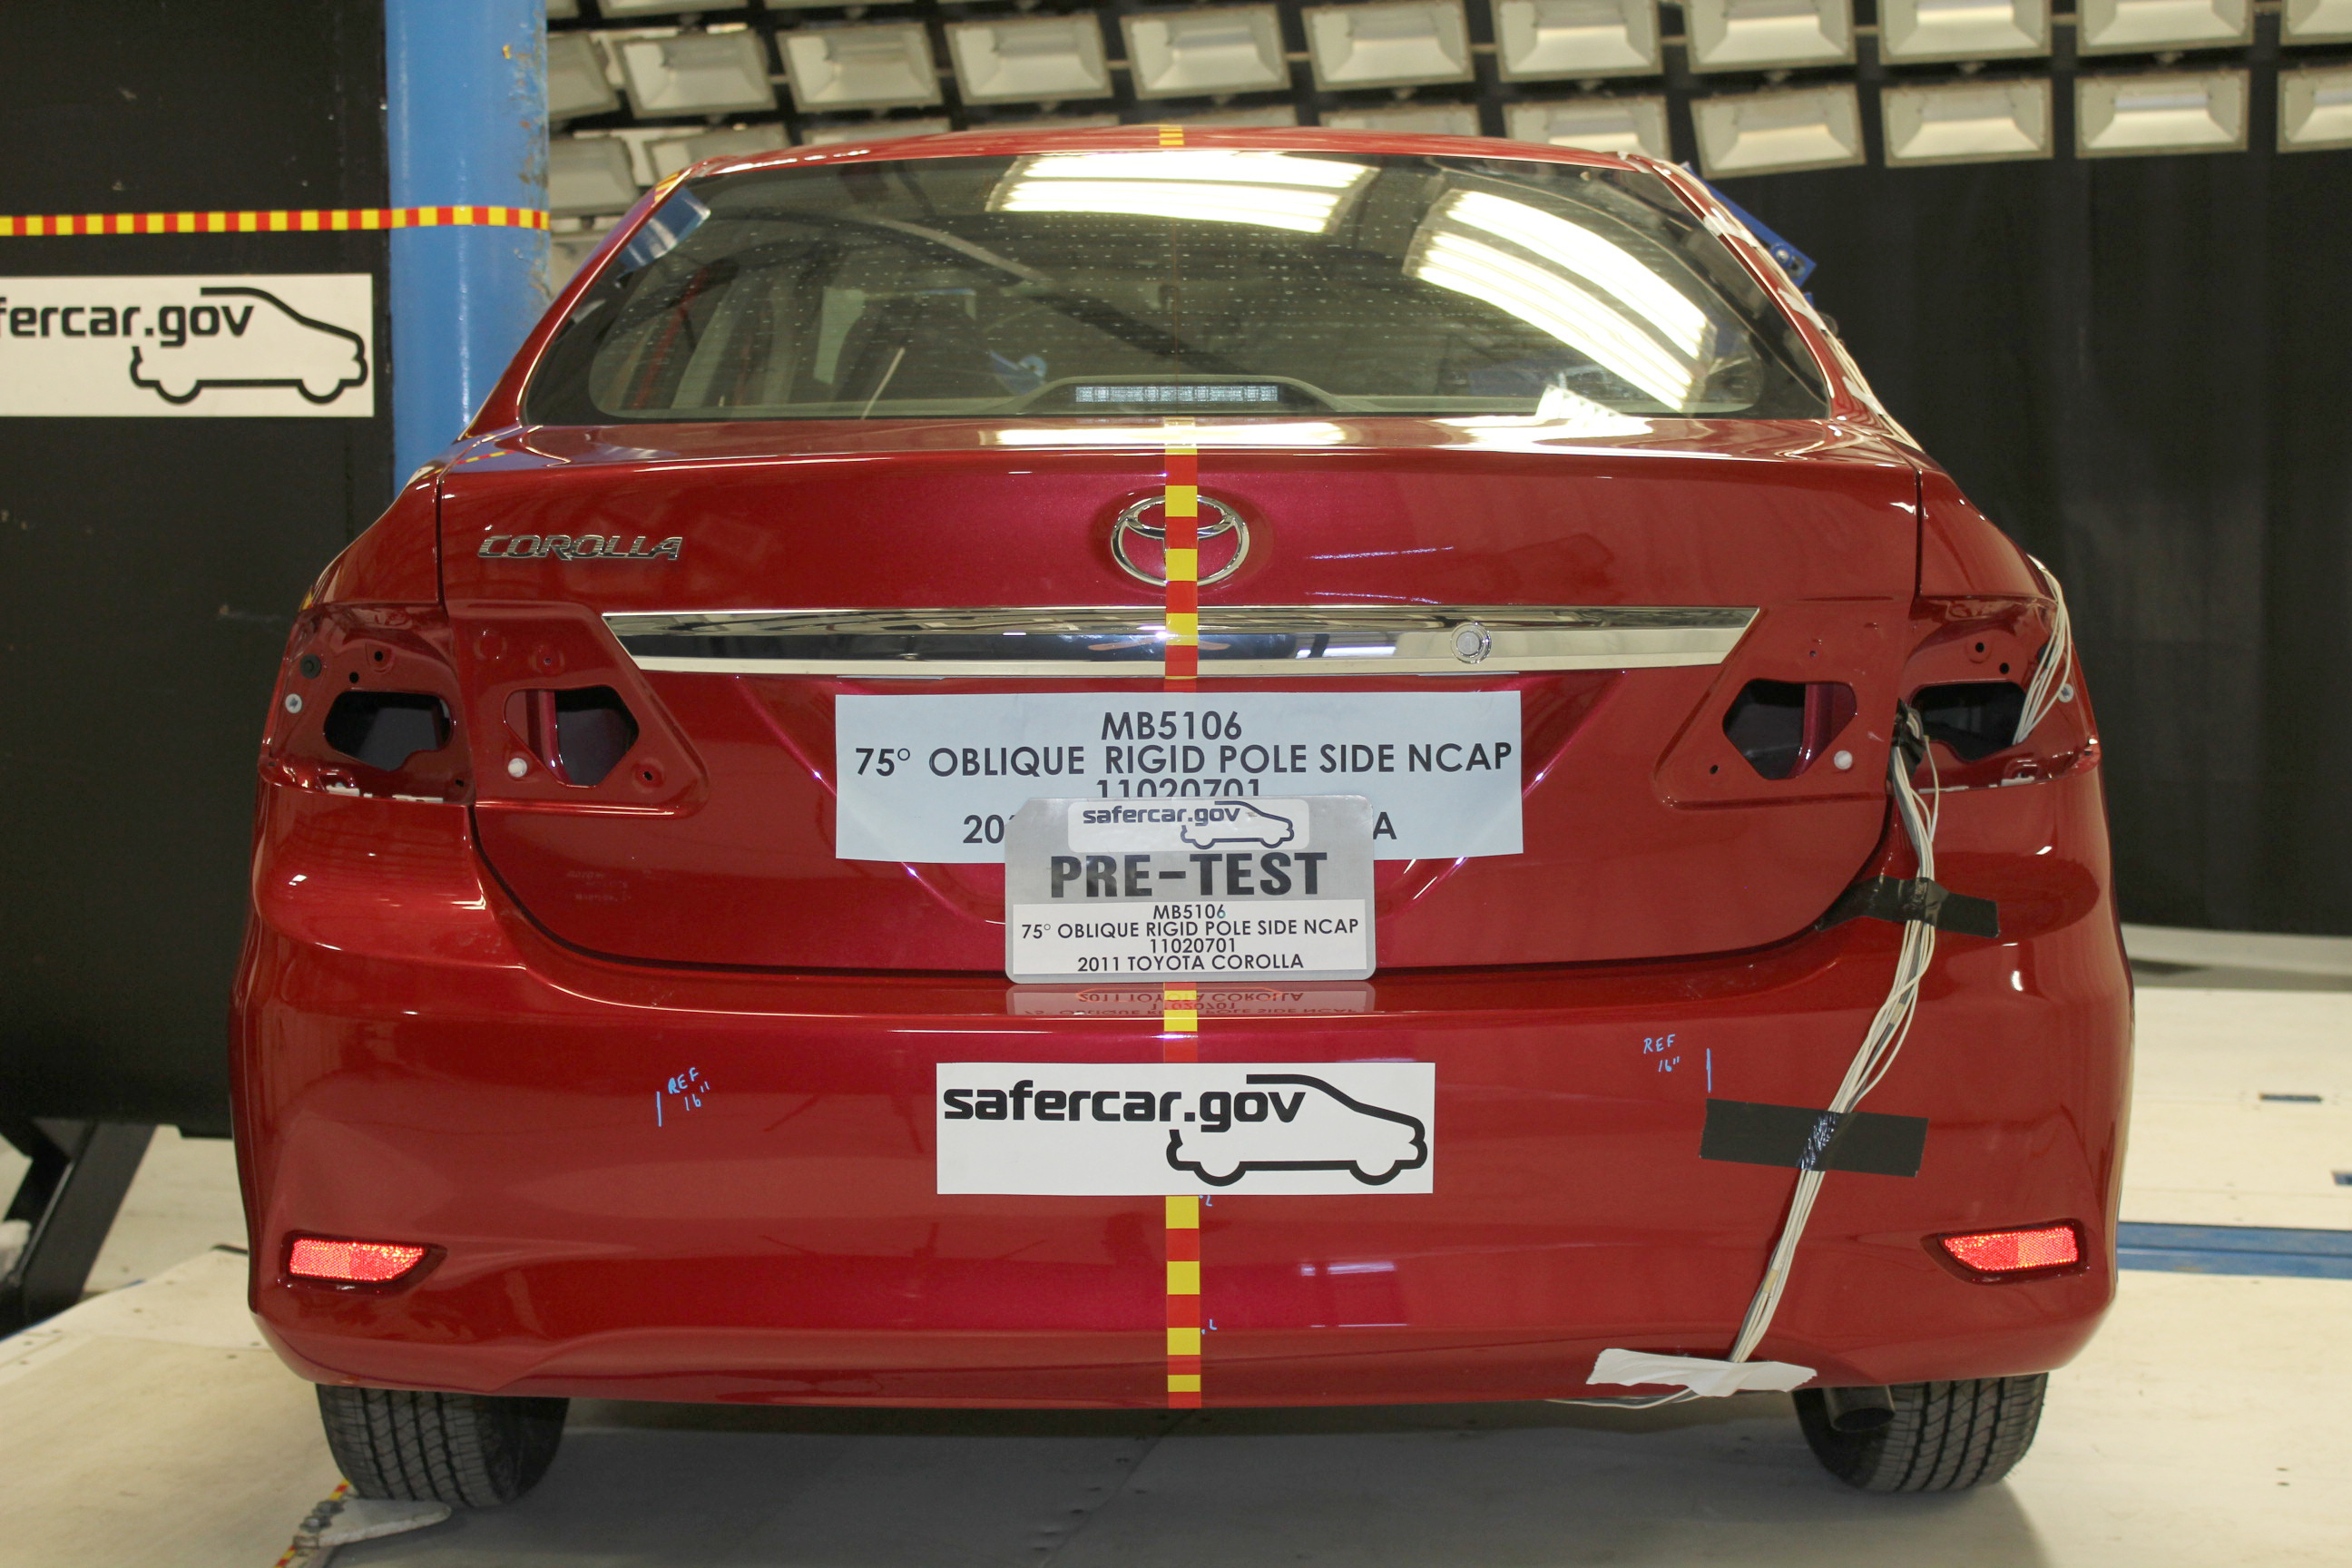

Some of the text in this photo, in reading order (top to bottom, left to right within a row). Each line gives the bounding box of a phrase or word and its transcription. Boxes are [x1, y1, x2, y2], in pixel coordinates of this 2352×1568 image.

[477, 534, 683, 561] COROLLA
[1101, 710, 1242, 740] MB5106
[855, 741, 1512, 778] 75° OBLIQUE RIGID POLE SIDE NCAP
[1083, 805, 1240, 827] safercar.gov
[1051, 852, 1328, 898] PRE-TEST
[1153, 903, 1227, 920] MB5106
[1022, 918, 1359, 939] 75° OBLIQUE RIGID POLE SIDE NCAP
[1150, 937, 1236, 954] 11020701
[1077, 954, 1304, 972] 2011 TOYOTA COROLLA
[1643, 1033, 1676, 1054] REF
[667, 1066, 700, 1094] REF
[943, 1079, 1307, 1133] safercar.gov
